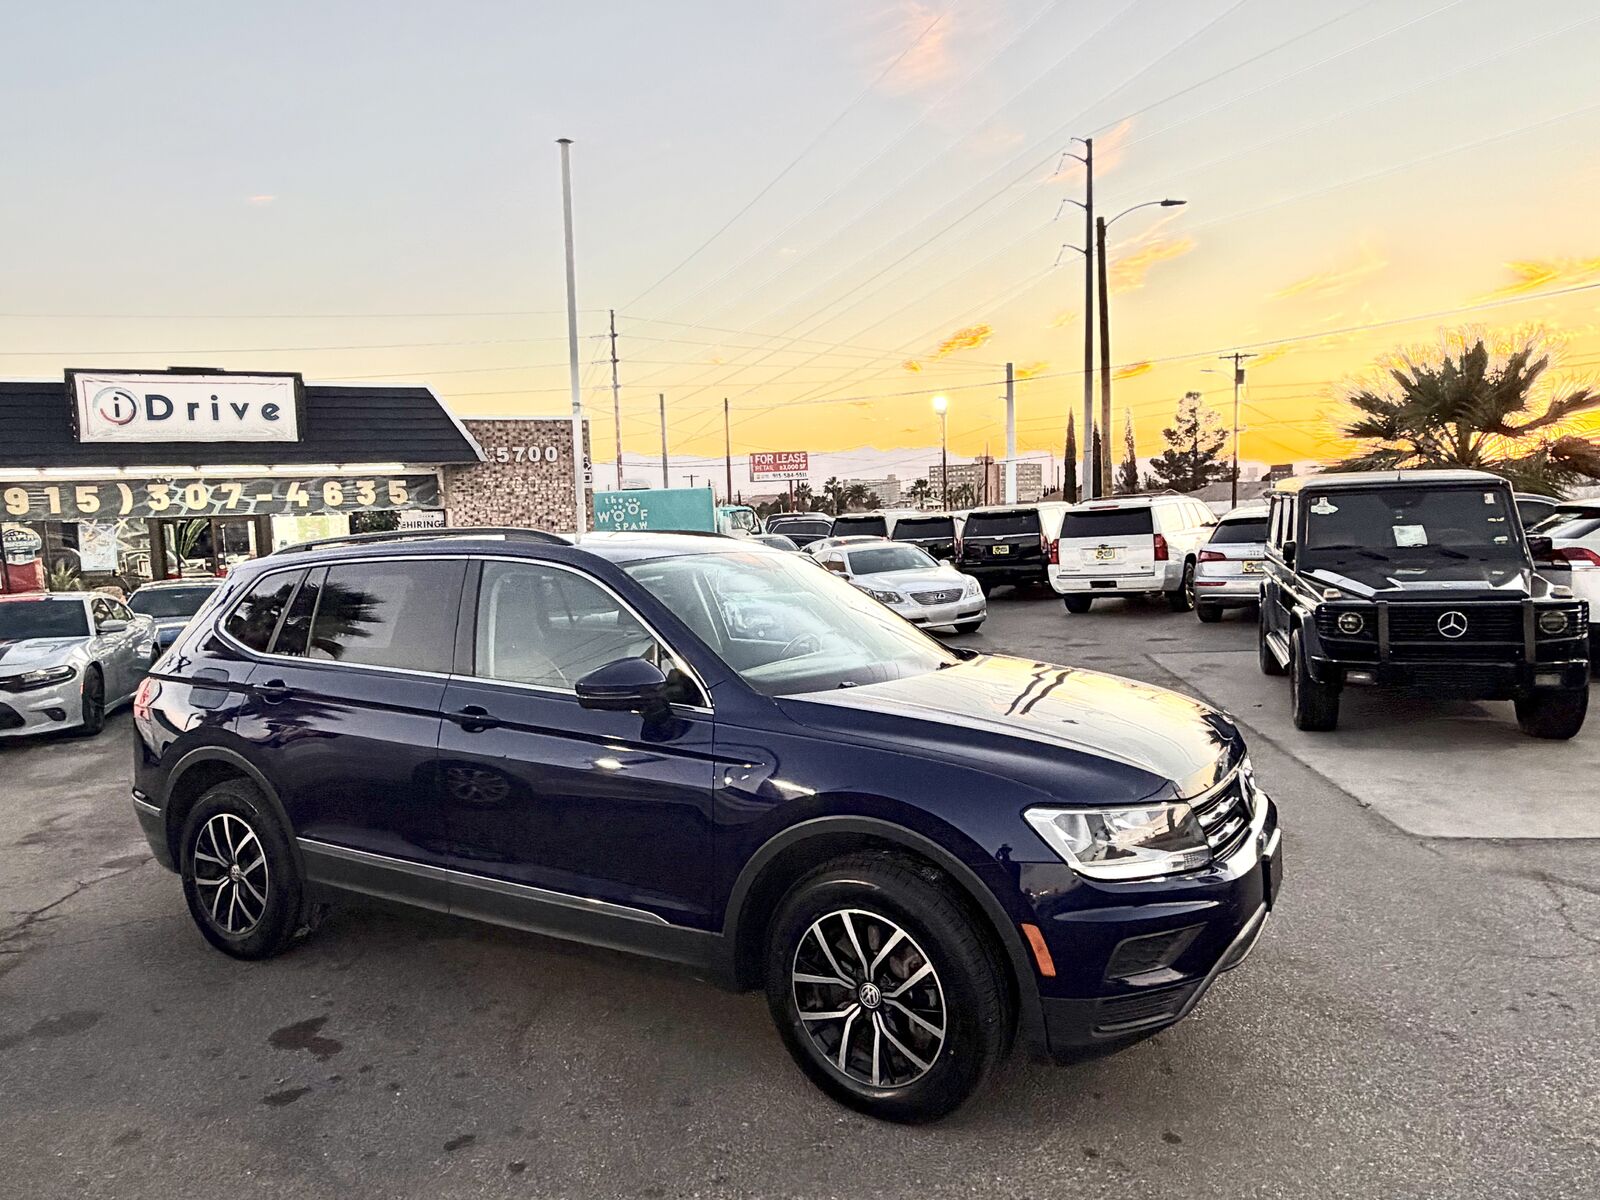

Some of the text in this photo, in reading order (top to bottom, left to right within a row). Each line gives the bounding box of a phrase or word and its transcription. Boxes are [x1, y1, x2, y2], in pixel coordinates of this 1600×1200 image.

[112, 395, 280, 420] iDrive
[496, 446, 558, 463] 5700
[755, 453, 806, 464] FOR LEASE
[604, 496, 623, 504] the
[597, 503, 648, 522] WOOF
[407, 520, 441, 529] HIRING
[615, 521, 648, 531] SPAW
